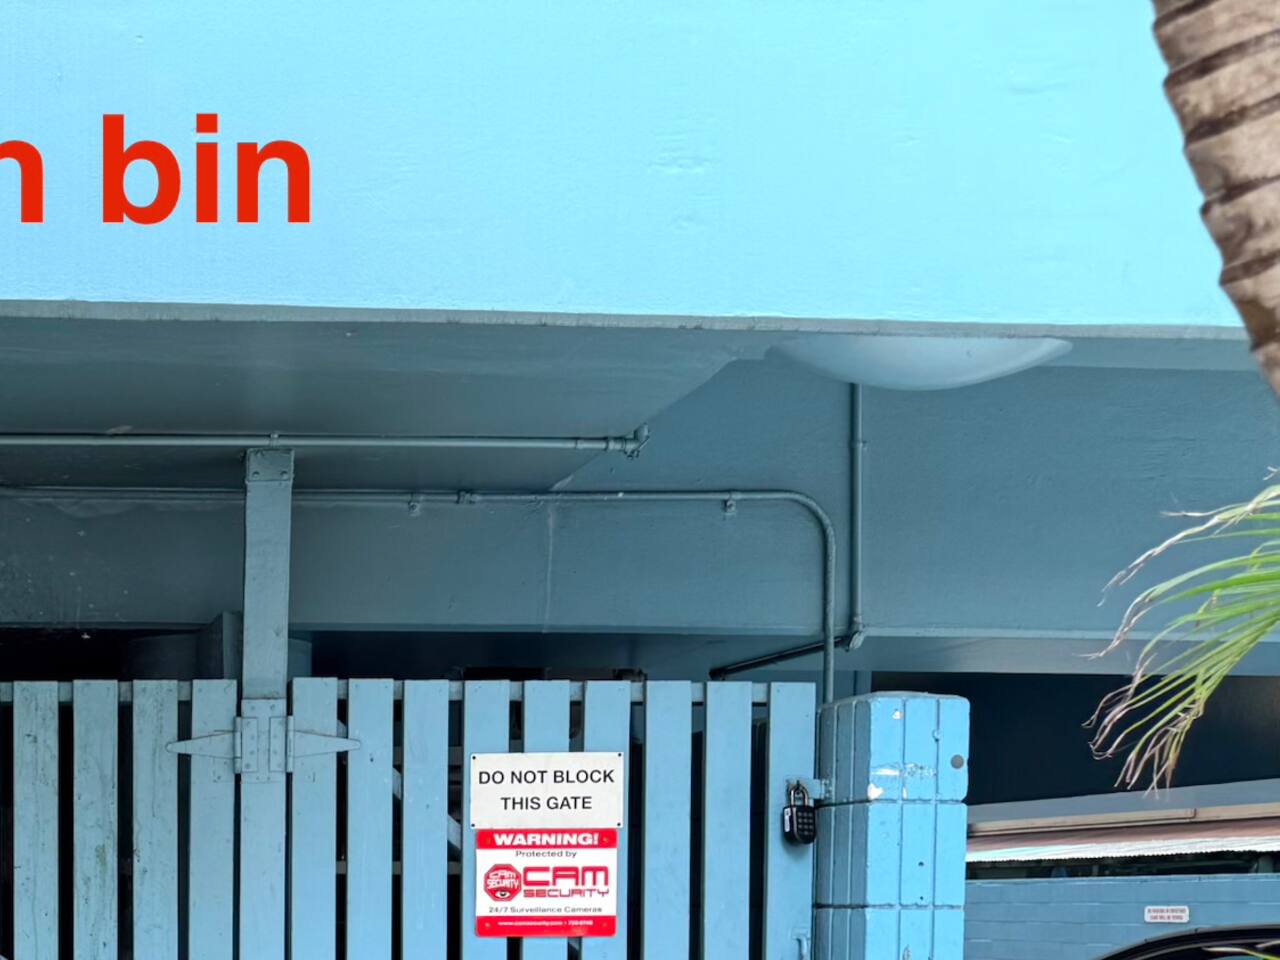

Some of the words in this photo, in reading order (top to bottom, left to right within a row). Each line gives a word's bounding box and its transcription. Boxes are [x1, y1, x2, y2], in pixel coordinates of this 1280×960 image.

[478, 771, 505, 785] DO
[510, 770, 548, 784] NOT
[553, 769, 615, 784] BLOCK
[500, 796, 541, 810] THIS
[546, 796, 592, 810] GATE
[493, 833, 599, 846] WARNING!
[515, 850, 563, 858] Protected
[565, 850, 578, 859] by
[522, 866, 609, 887] CAM
[523, 888, 610, 898] SECURITY
